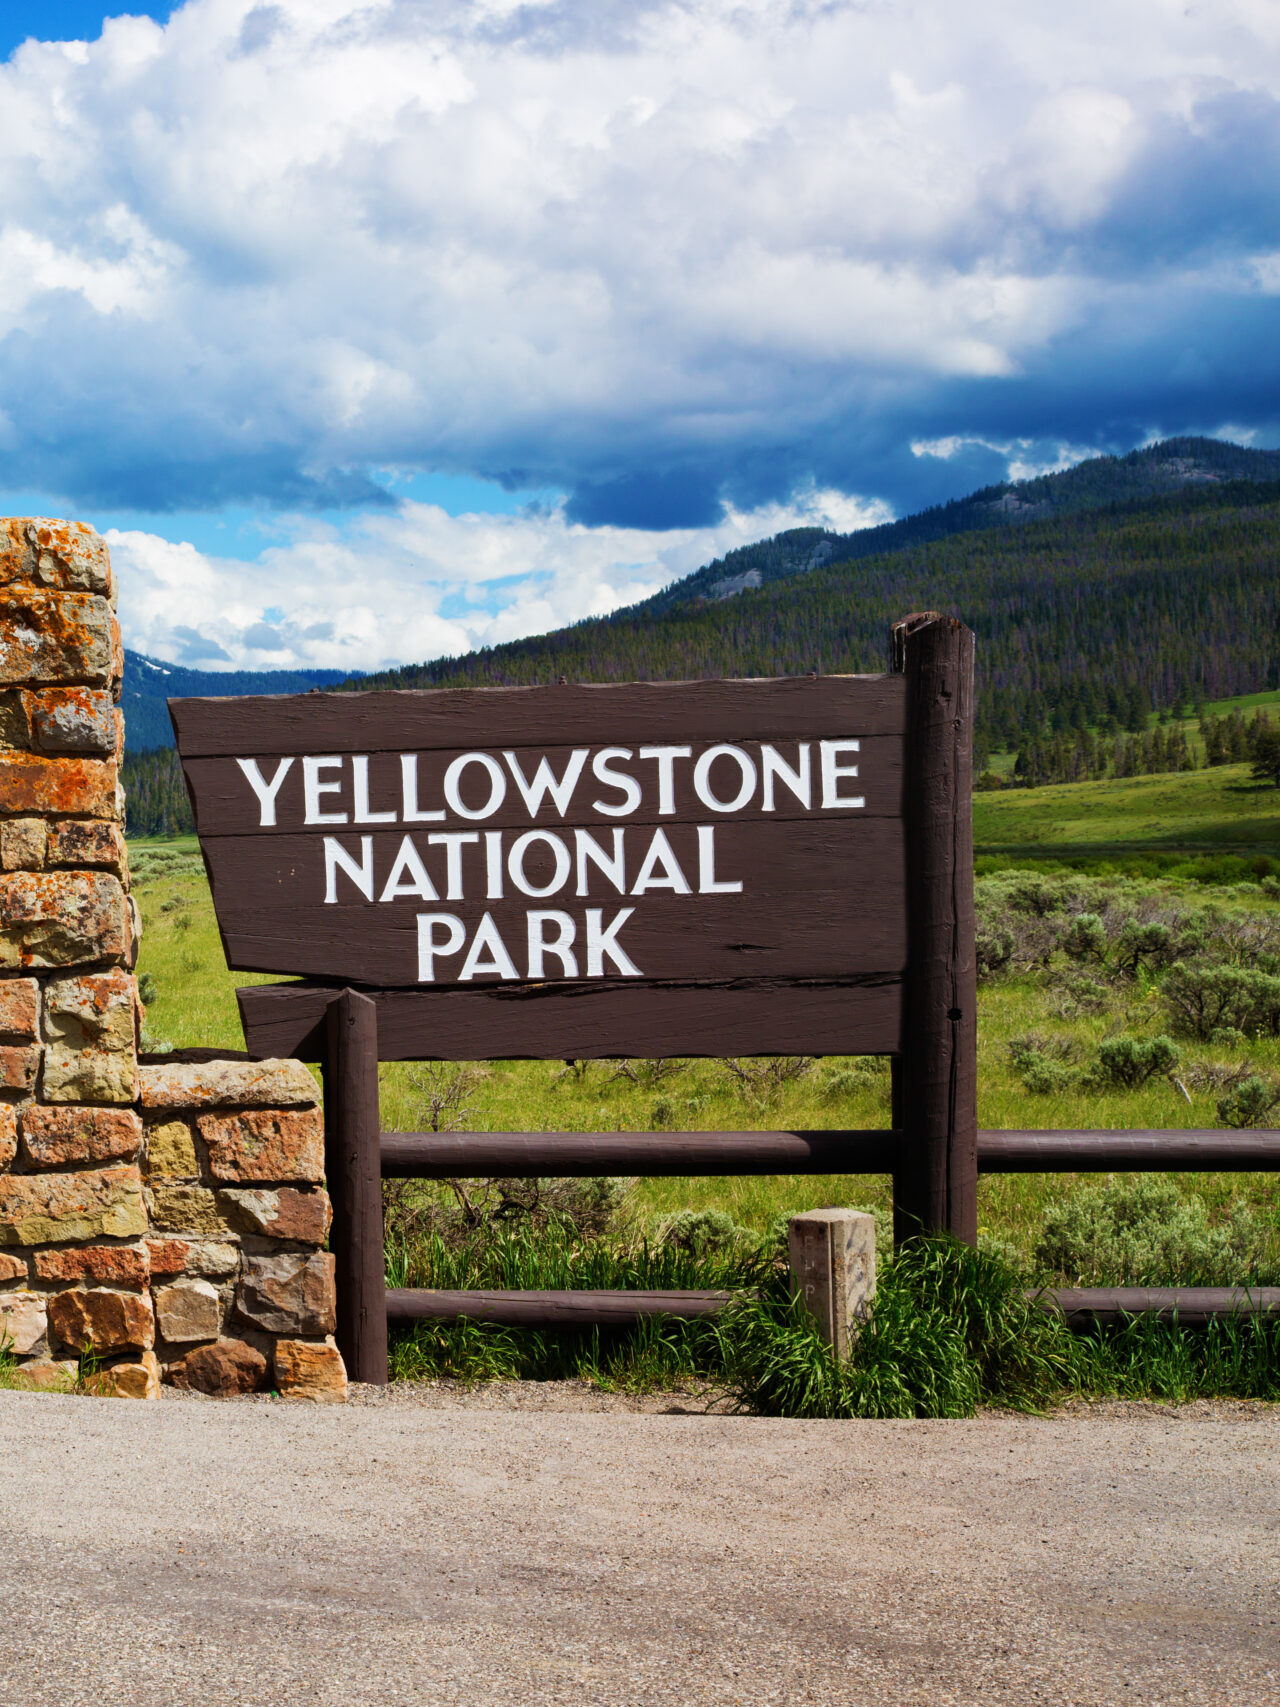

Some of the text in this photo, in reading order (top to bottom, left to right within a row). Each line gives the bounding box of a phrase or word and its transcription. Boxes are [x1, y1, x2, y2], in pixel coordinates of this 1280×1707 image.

[235, 740, 866, 826] YELLOWSTONE
[322, 826, 744, 904] NATIONAL
[416, 907, 644, 982] PARK
